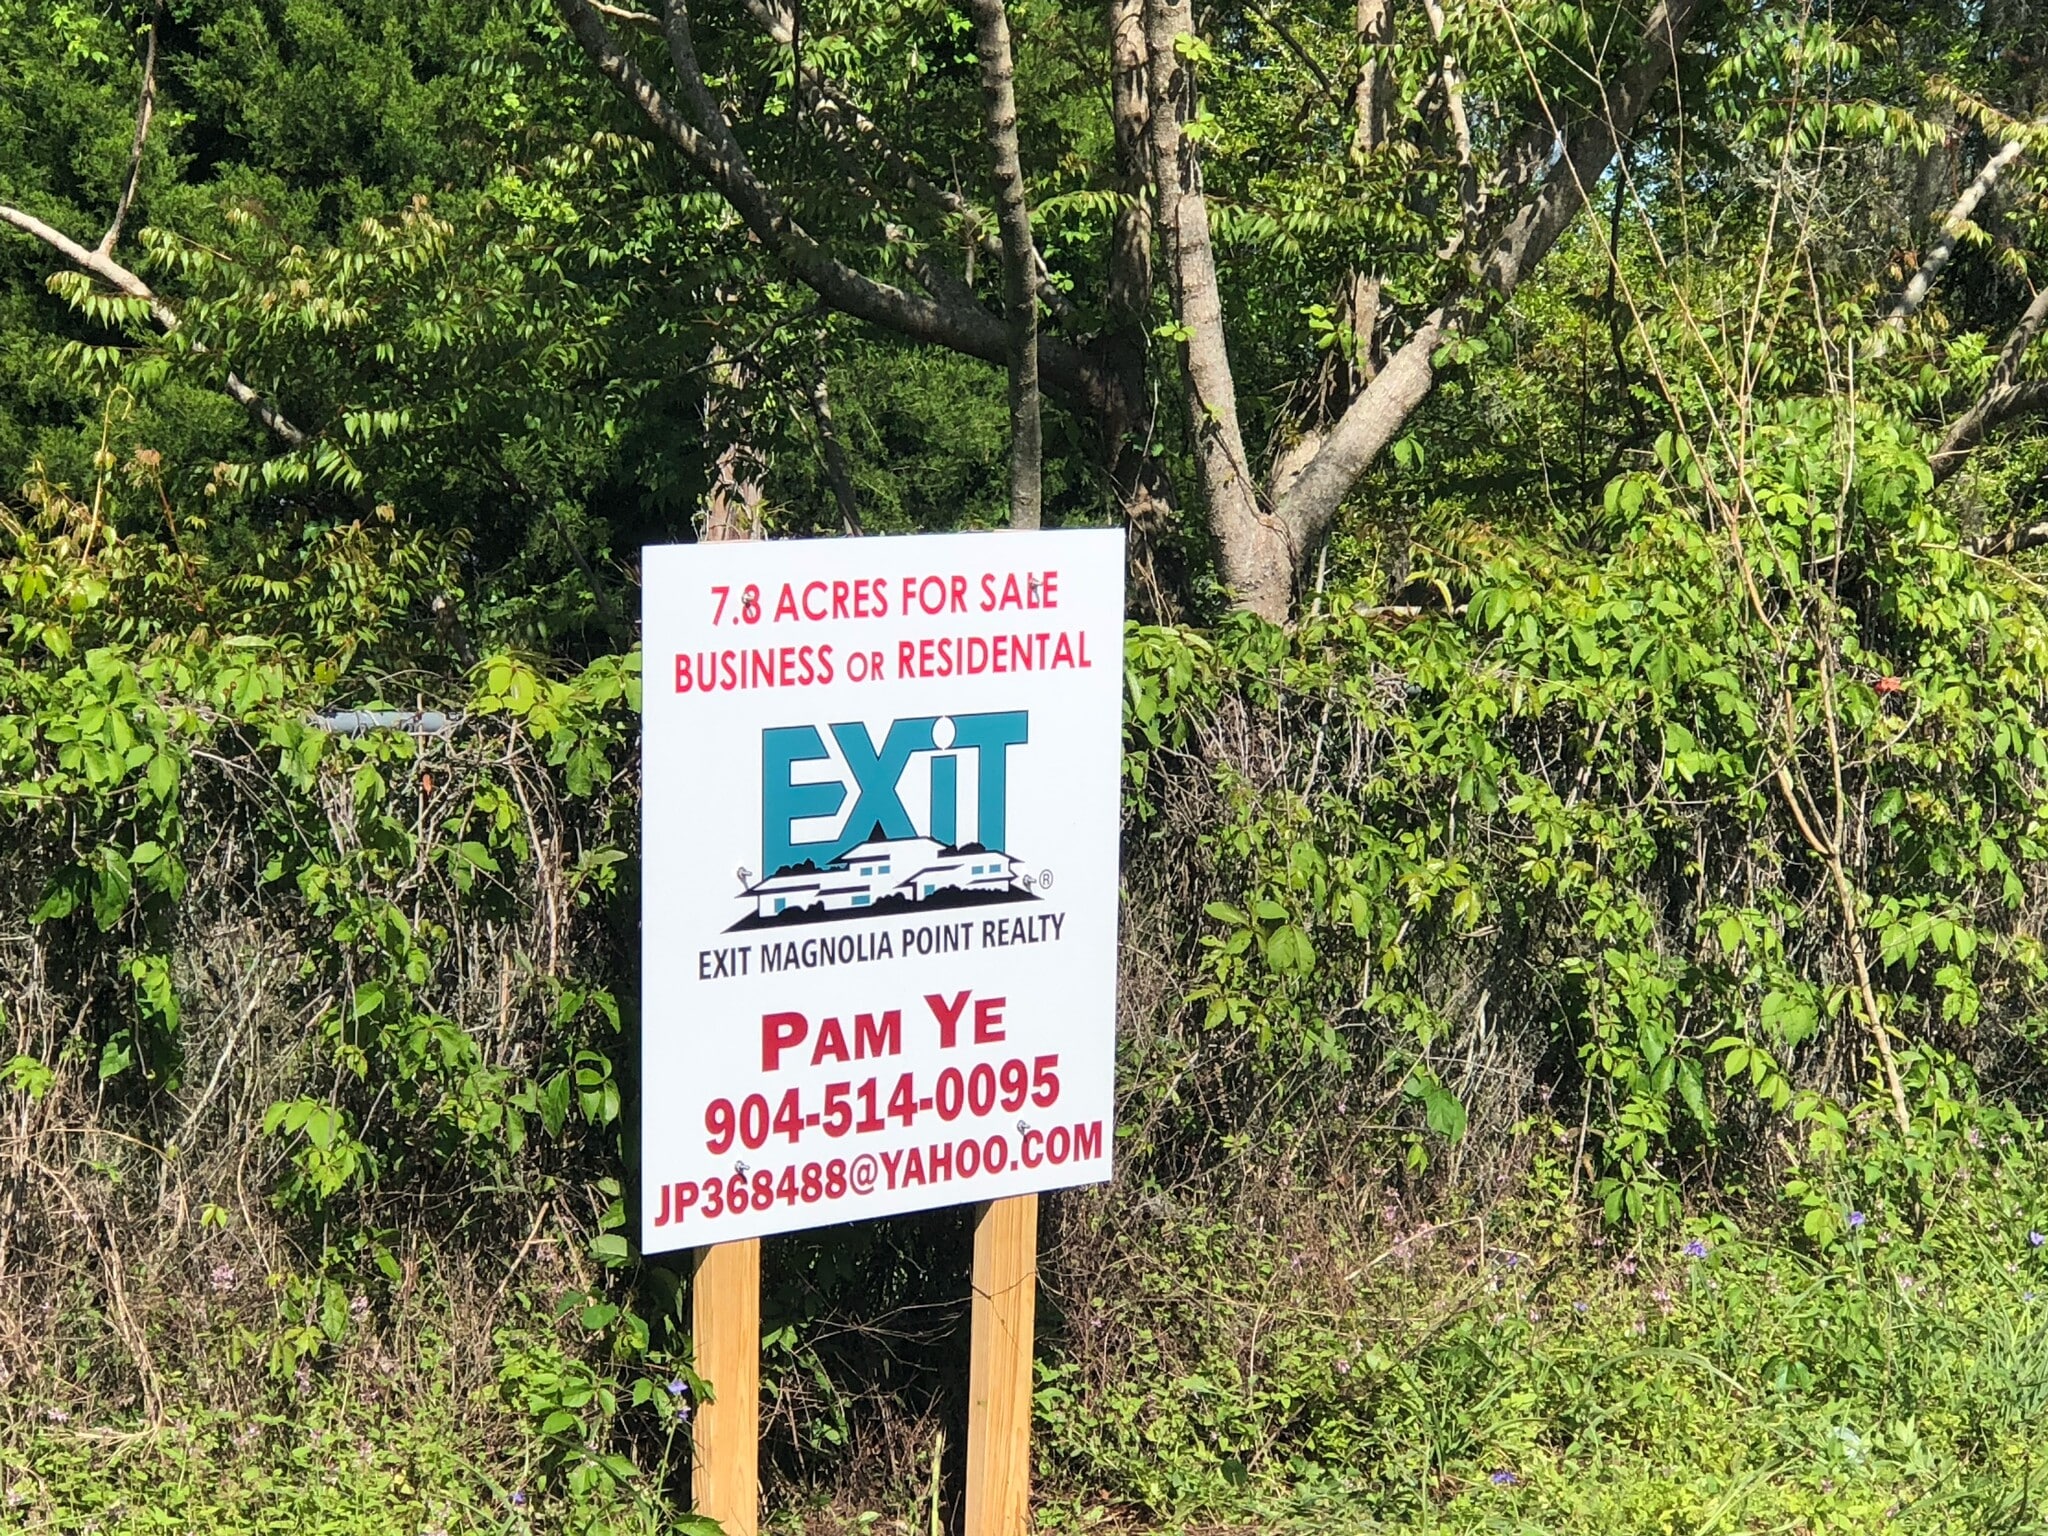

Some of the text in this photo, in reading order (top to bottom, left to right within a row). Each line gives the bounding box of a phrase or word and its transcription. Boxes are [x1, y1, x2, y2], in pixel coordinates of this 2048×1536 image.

[711, 571, 1058, 626] 7.8 ACRES FOR SALE
[675, 631, 1092, 693] BUSINESS OR RESIDENTAL
[699, 912, 1066, 980] EXIT MAGNOLIA POINT REALTY
[705, 1053, 1060, 1155] 904-514-0095
[654, 1120, 1103, 1227] JP368488@YAHOO.COM
